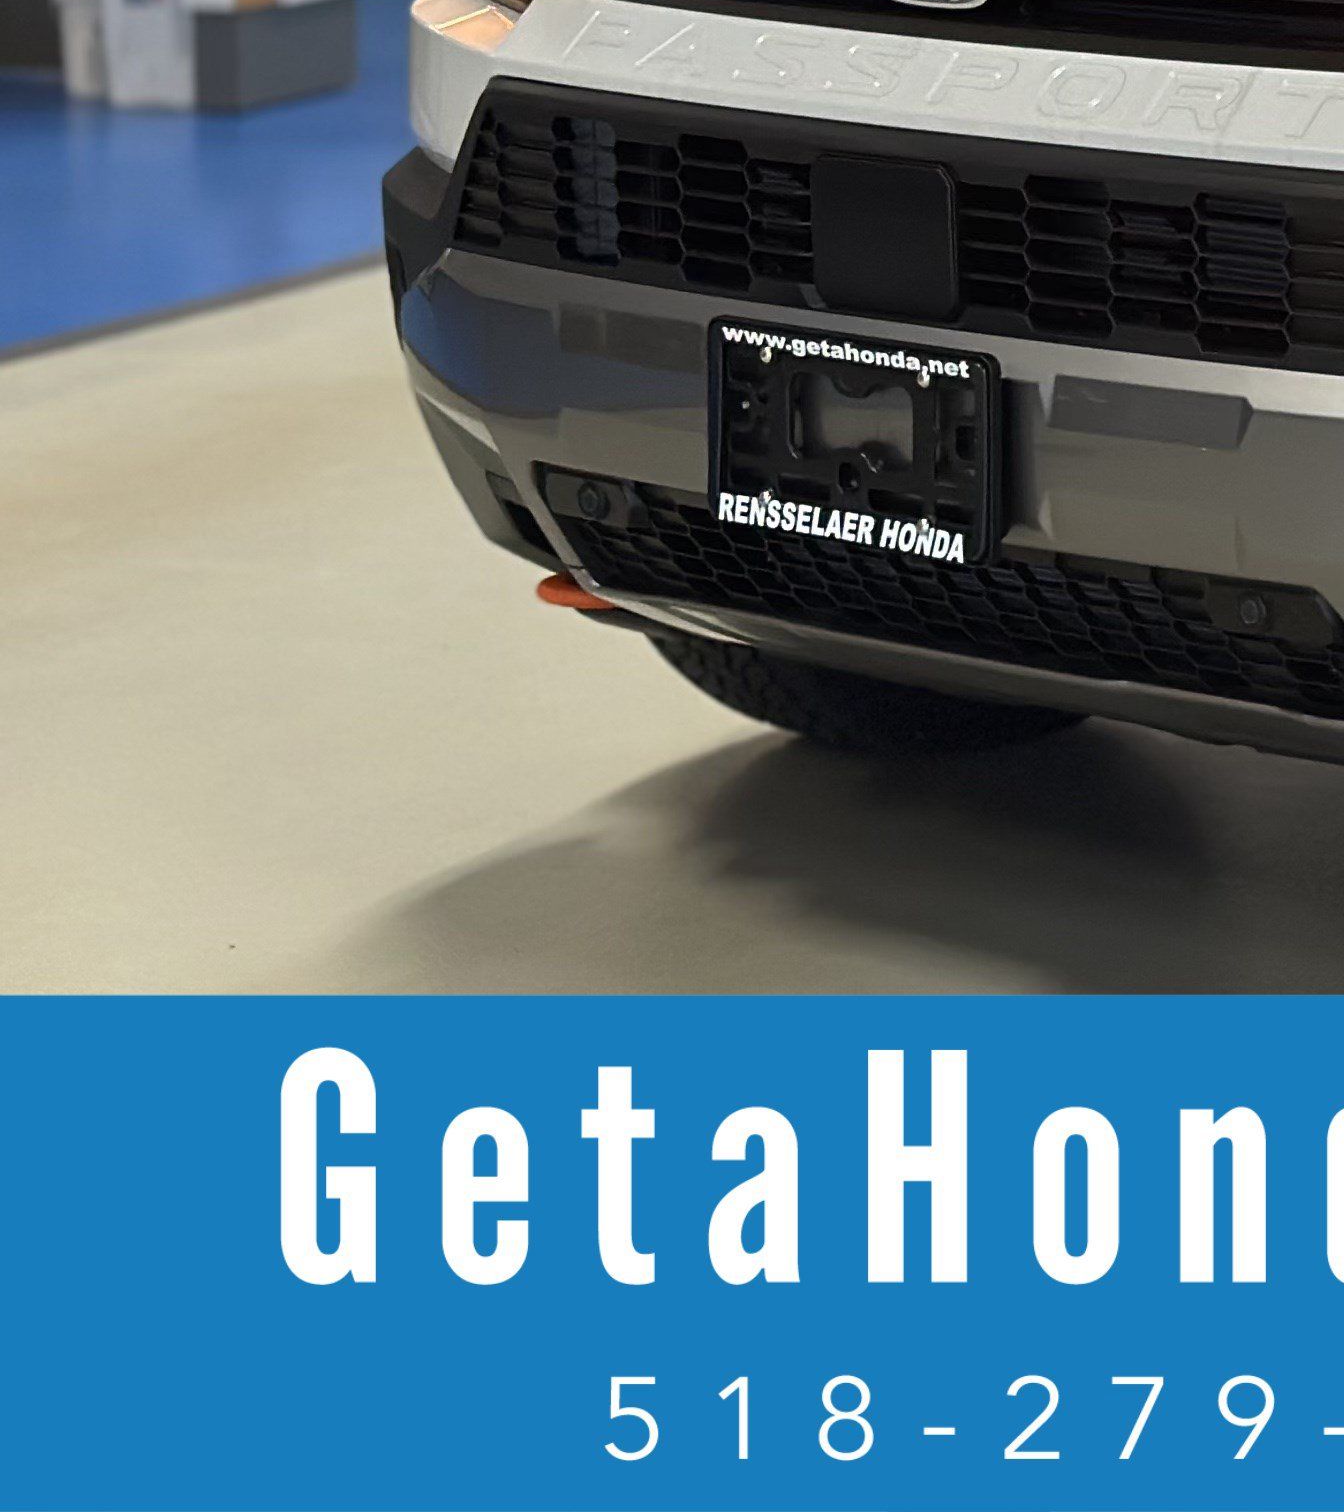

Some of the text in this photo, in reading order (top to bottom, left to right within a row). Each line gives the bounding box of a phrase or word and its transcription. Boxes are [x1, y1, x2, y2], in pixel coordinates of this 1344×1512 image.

[721, 325, 971, 380] www.getahonda.net
[717, 491, 965, 564] RENSSELAER HONDA
